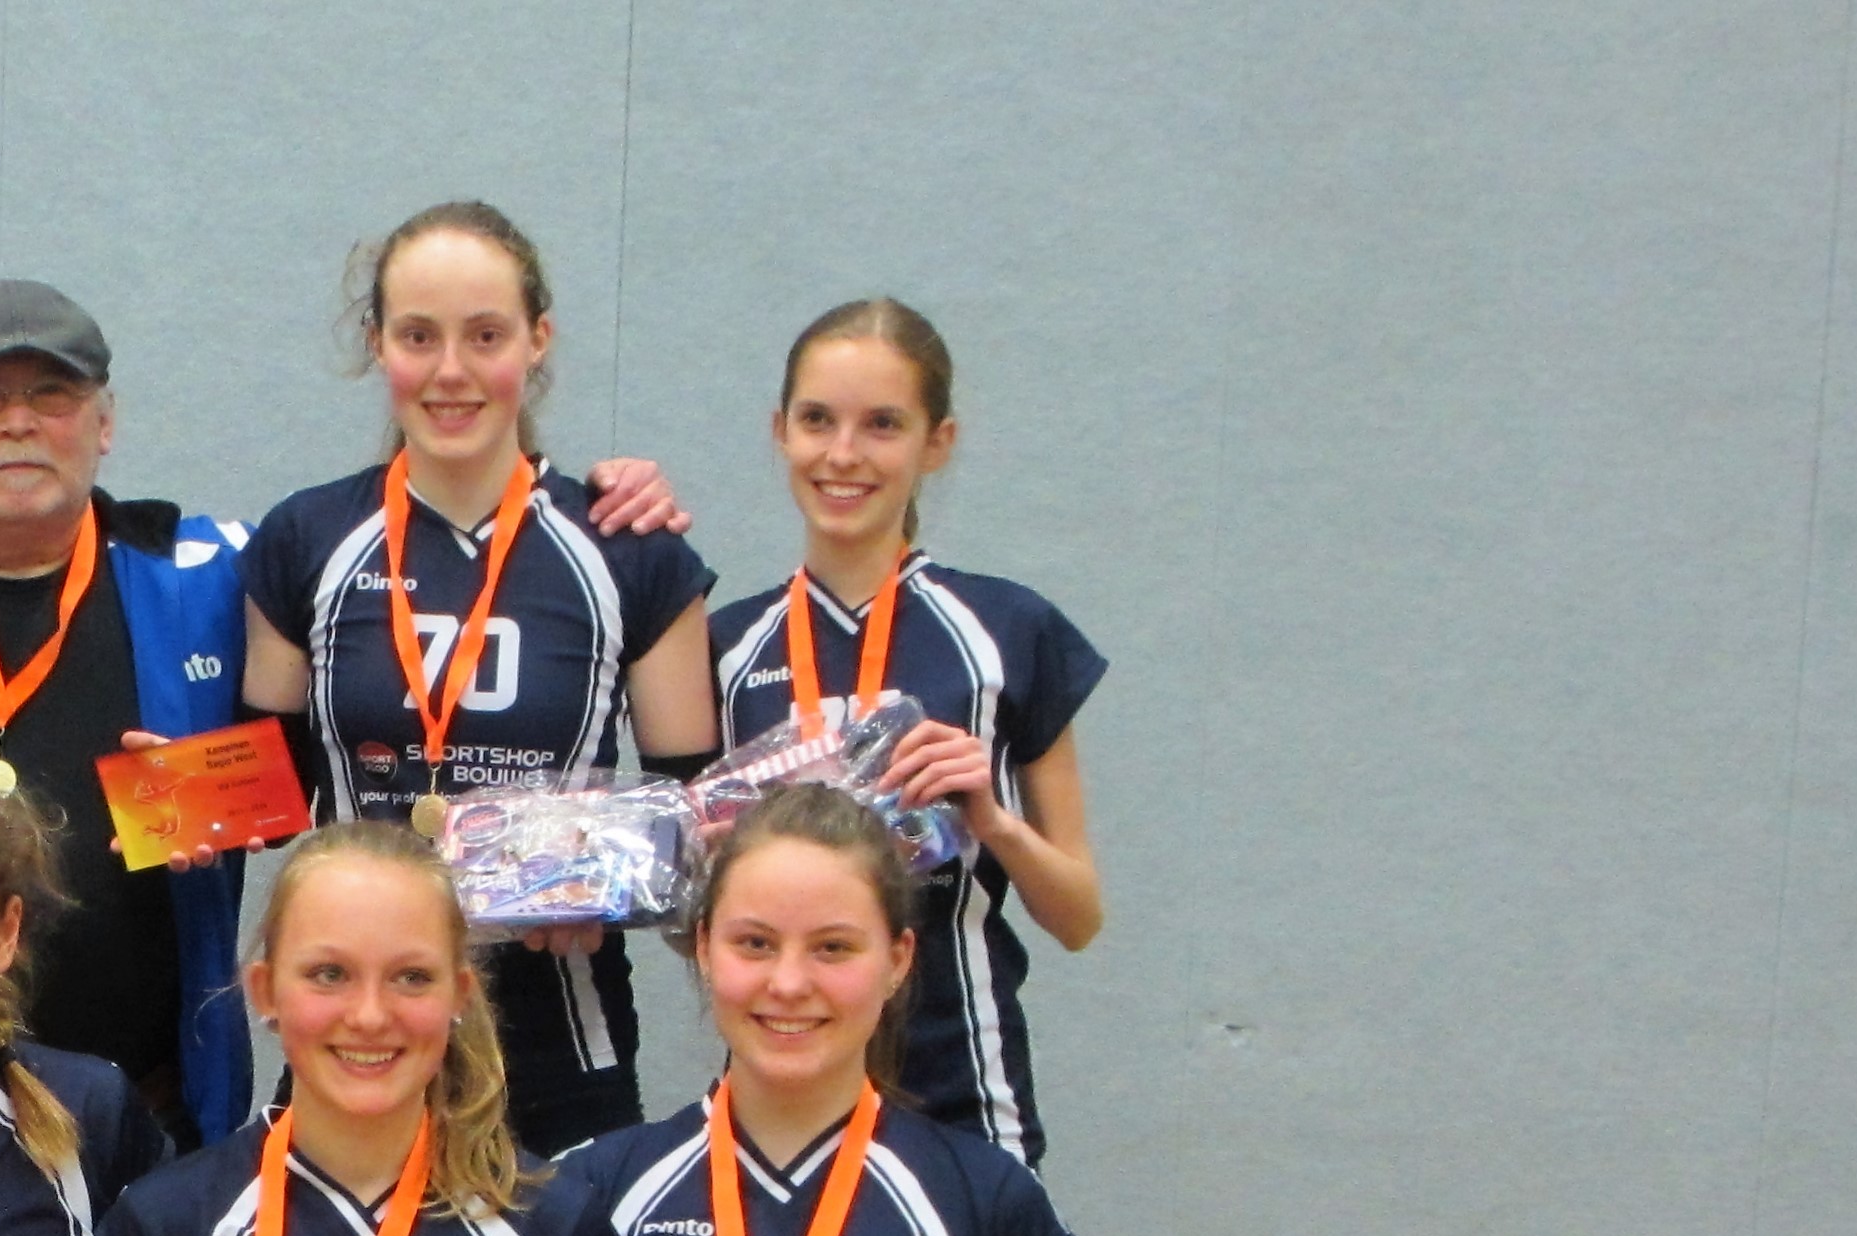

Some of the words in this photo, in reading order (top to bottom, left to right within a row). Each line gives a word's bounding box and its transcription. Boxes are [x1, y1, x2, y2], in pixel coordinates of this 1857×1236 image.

[356, 572, 418, 592] Dino
[403, 612, 521, 713] 70
[746, 665, 792, 688] Dint
[405, 743, 555, 768] SORTSHOP
[359, 790, 390, 806] your
